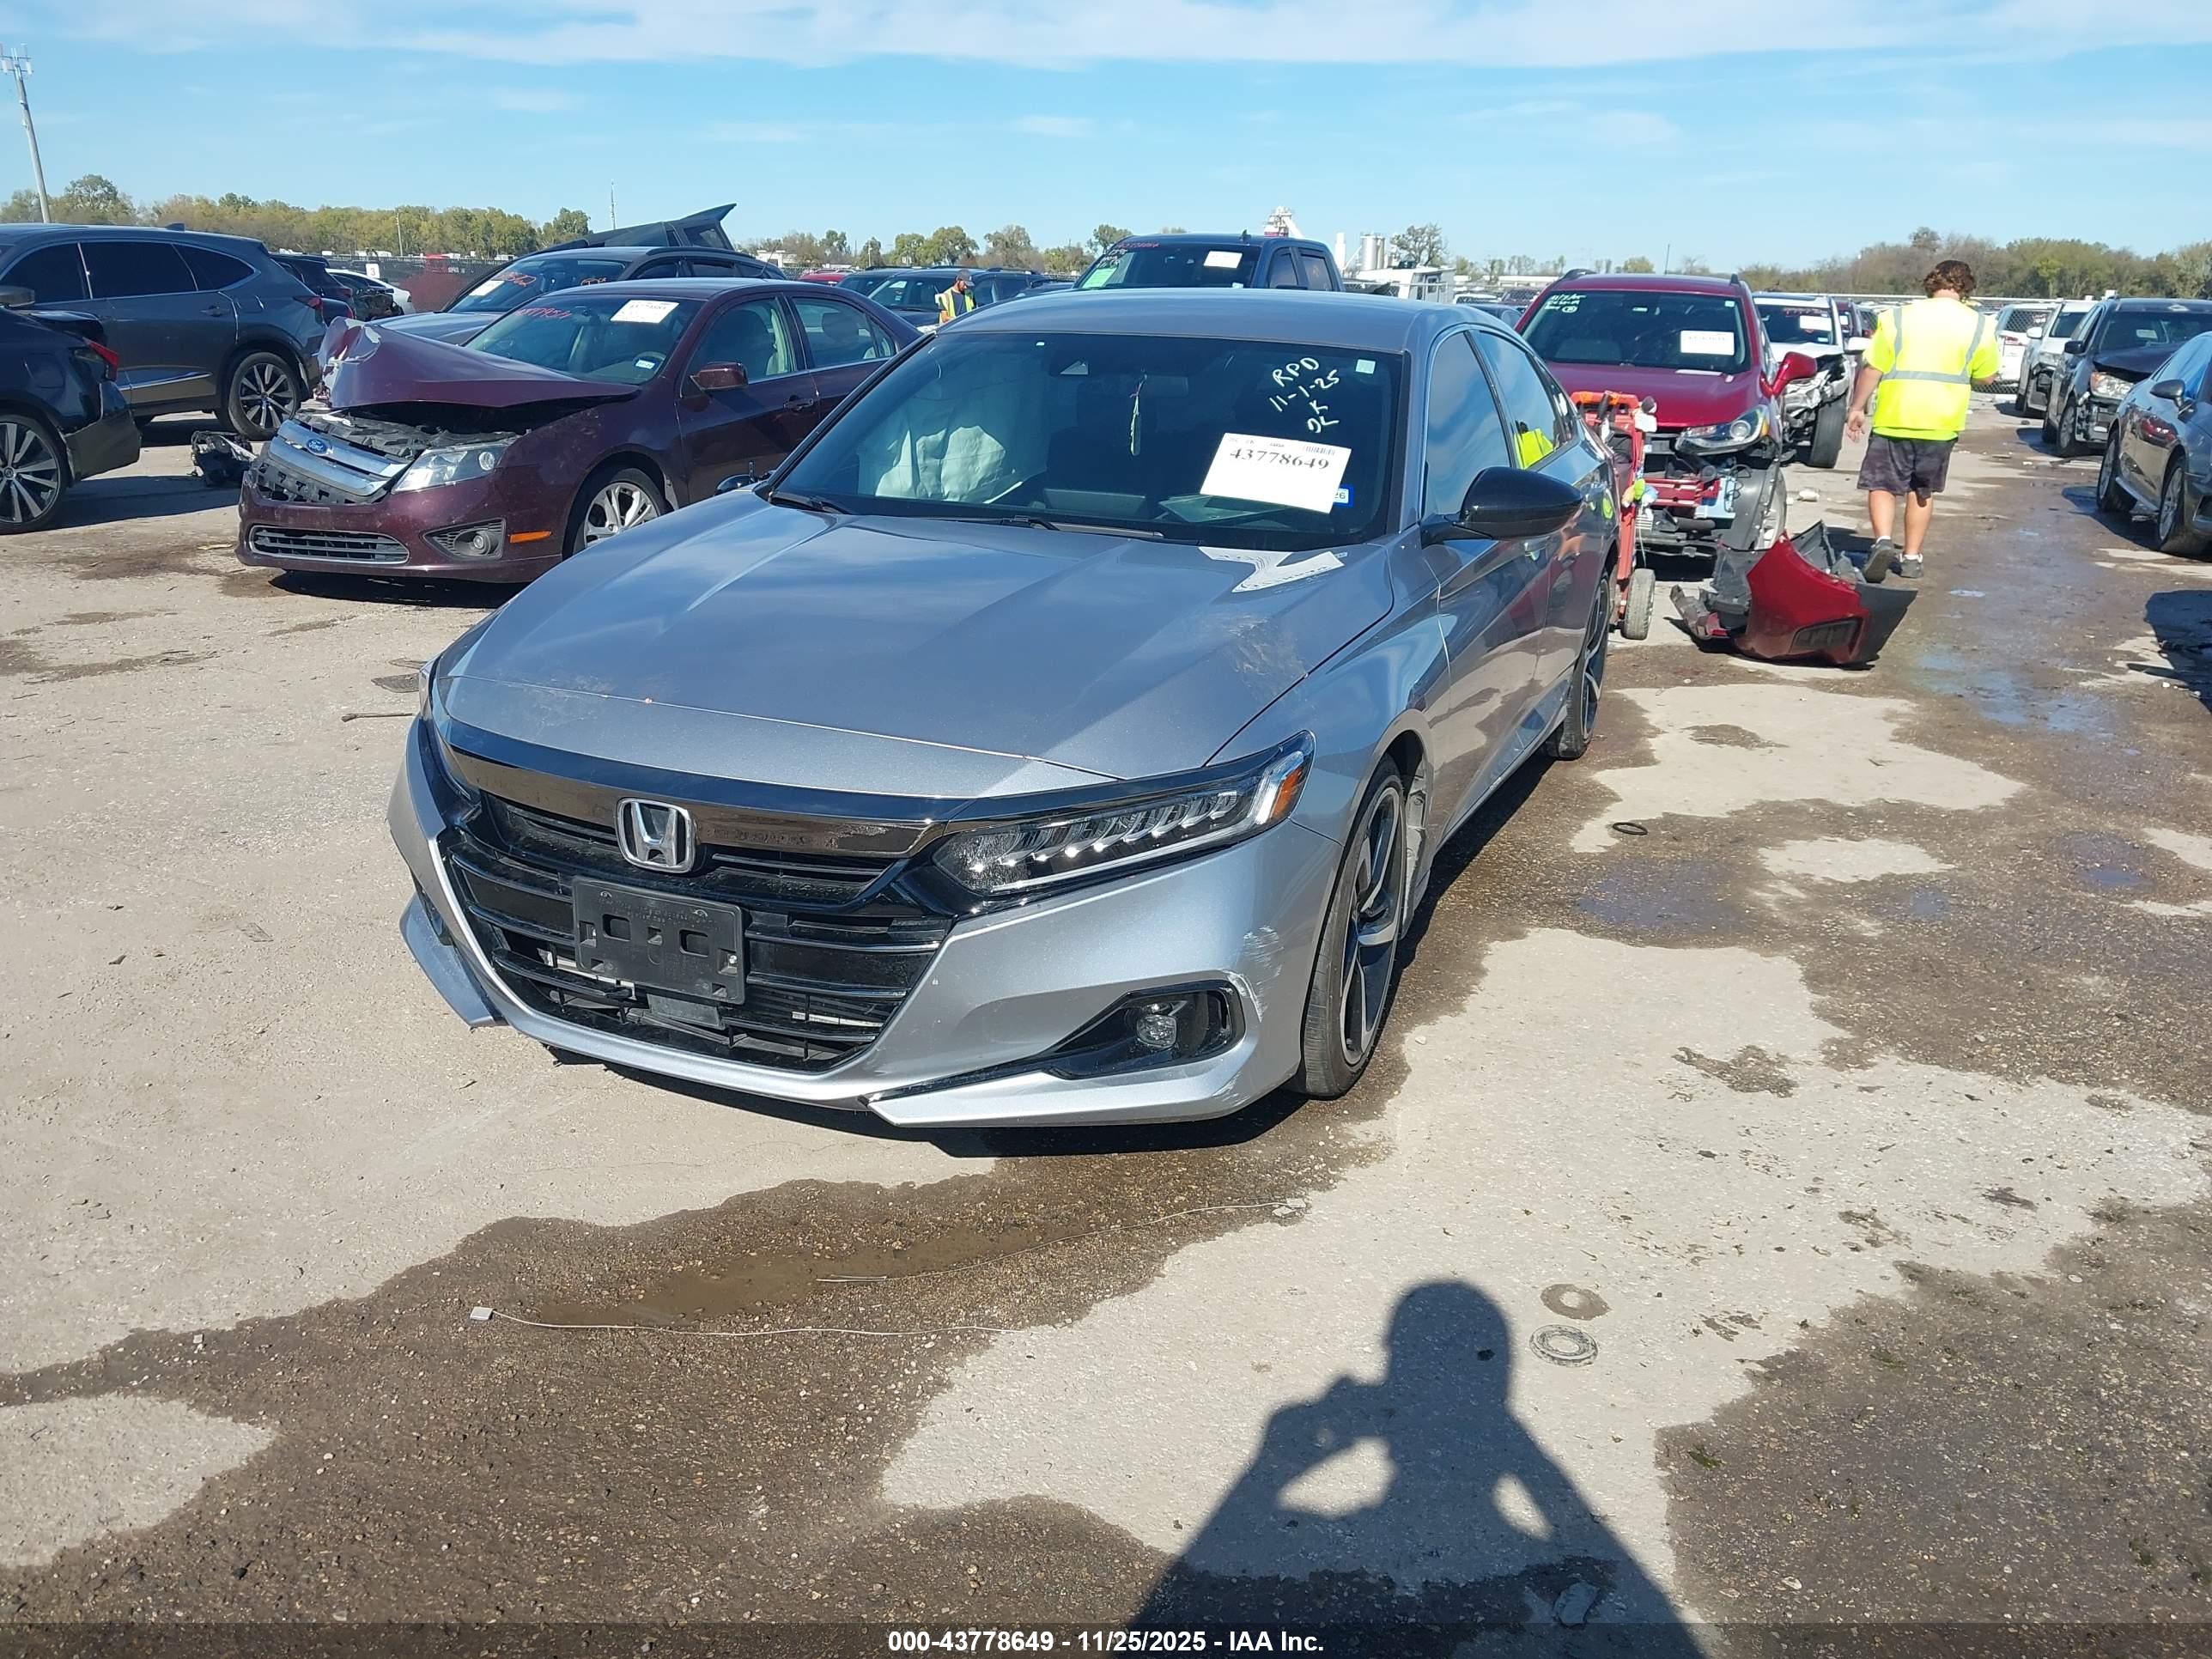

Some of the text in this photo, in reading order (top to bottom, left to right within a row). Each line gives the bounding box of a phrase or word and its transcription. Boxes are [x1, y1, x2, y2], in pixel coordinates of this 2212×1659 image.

[1272, 357, 1320, 387] RPD
[1268, 368, 1340, 412] 11-1-25
[307, 440, 325, 452] Ford
[1230, 447, 1330, 470] 43778649
